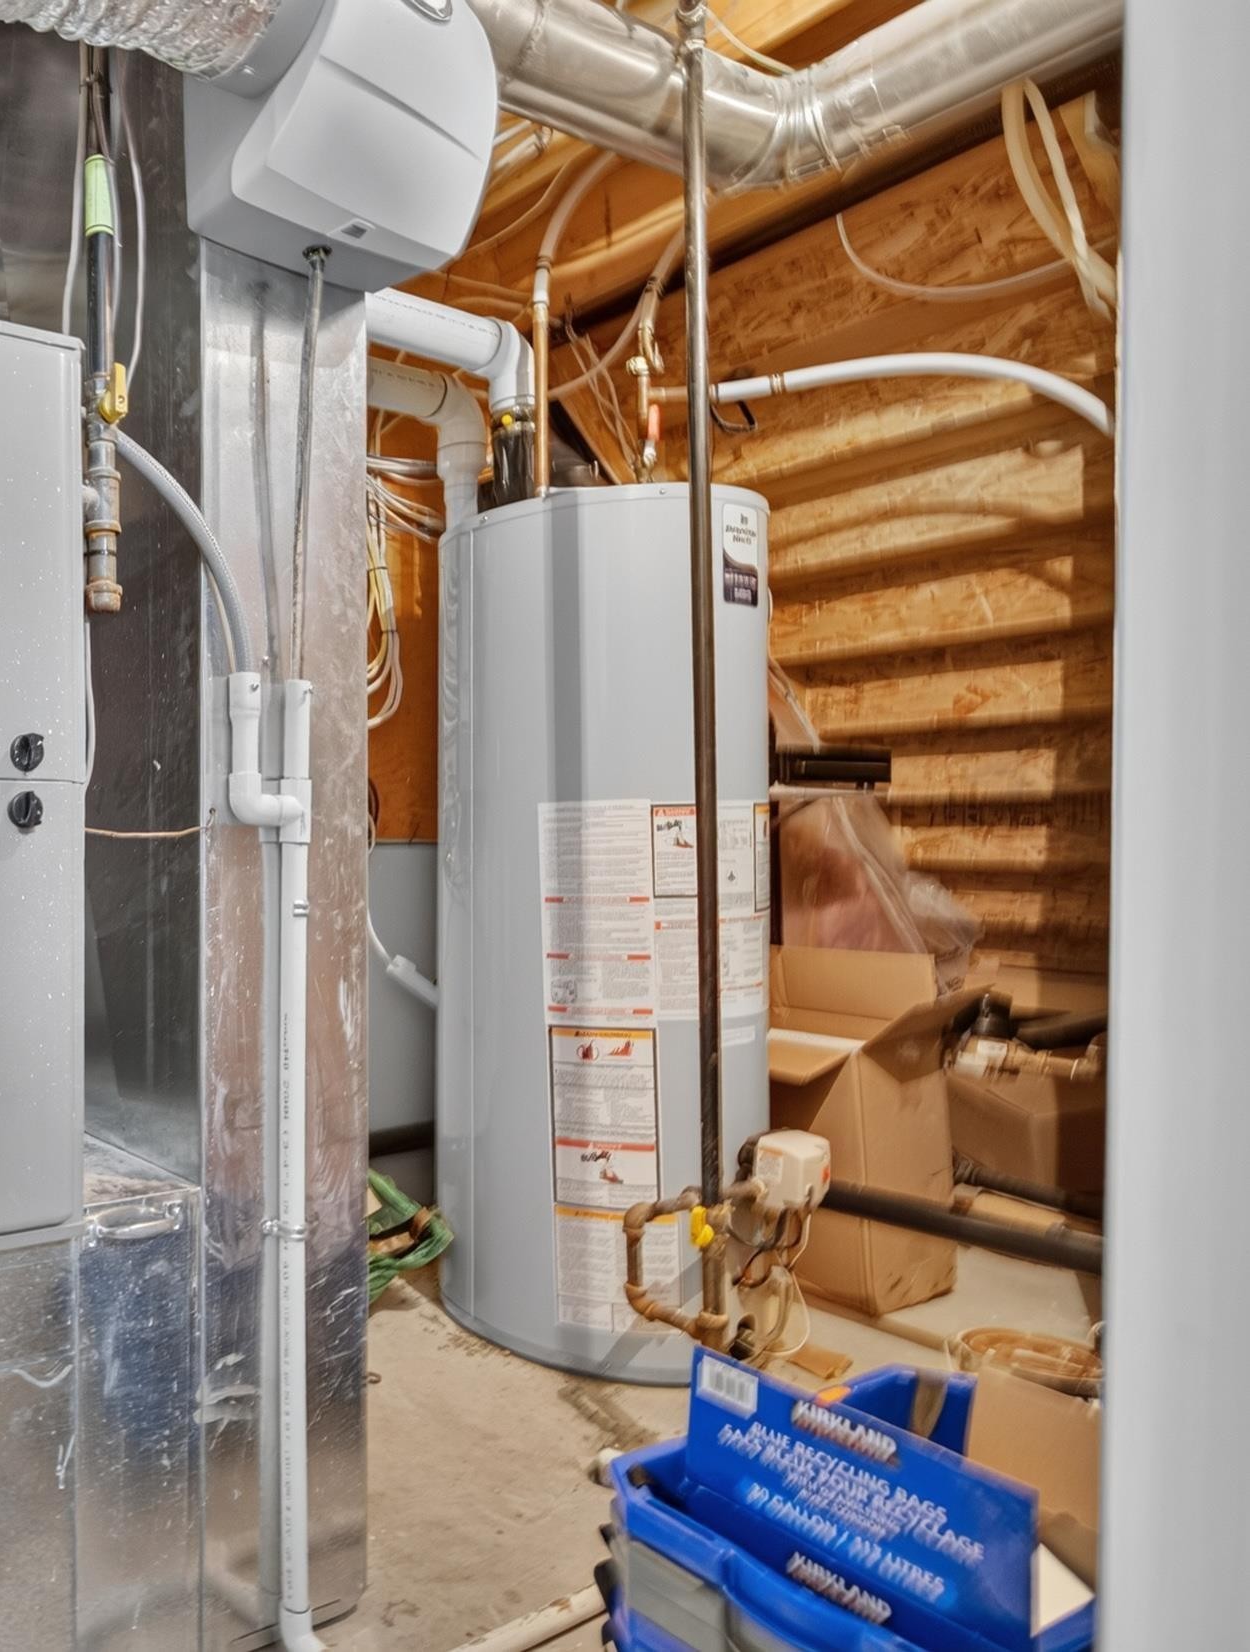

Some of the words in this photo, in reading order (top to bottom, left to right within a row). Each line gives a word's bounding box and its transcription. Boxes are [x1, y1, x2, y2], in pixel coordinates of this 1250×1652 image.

[791, 1400, 896, 1462] KIRKLAND
[746, 1421, 790, 1448] BLUE
[793, 1440, 890, 1495] RECYCLING
[895, 1486, 947, 1524] BAGS
[786, 1551, 892, 1624] KIRKLAND
